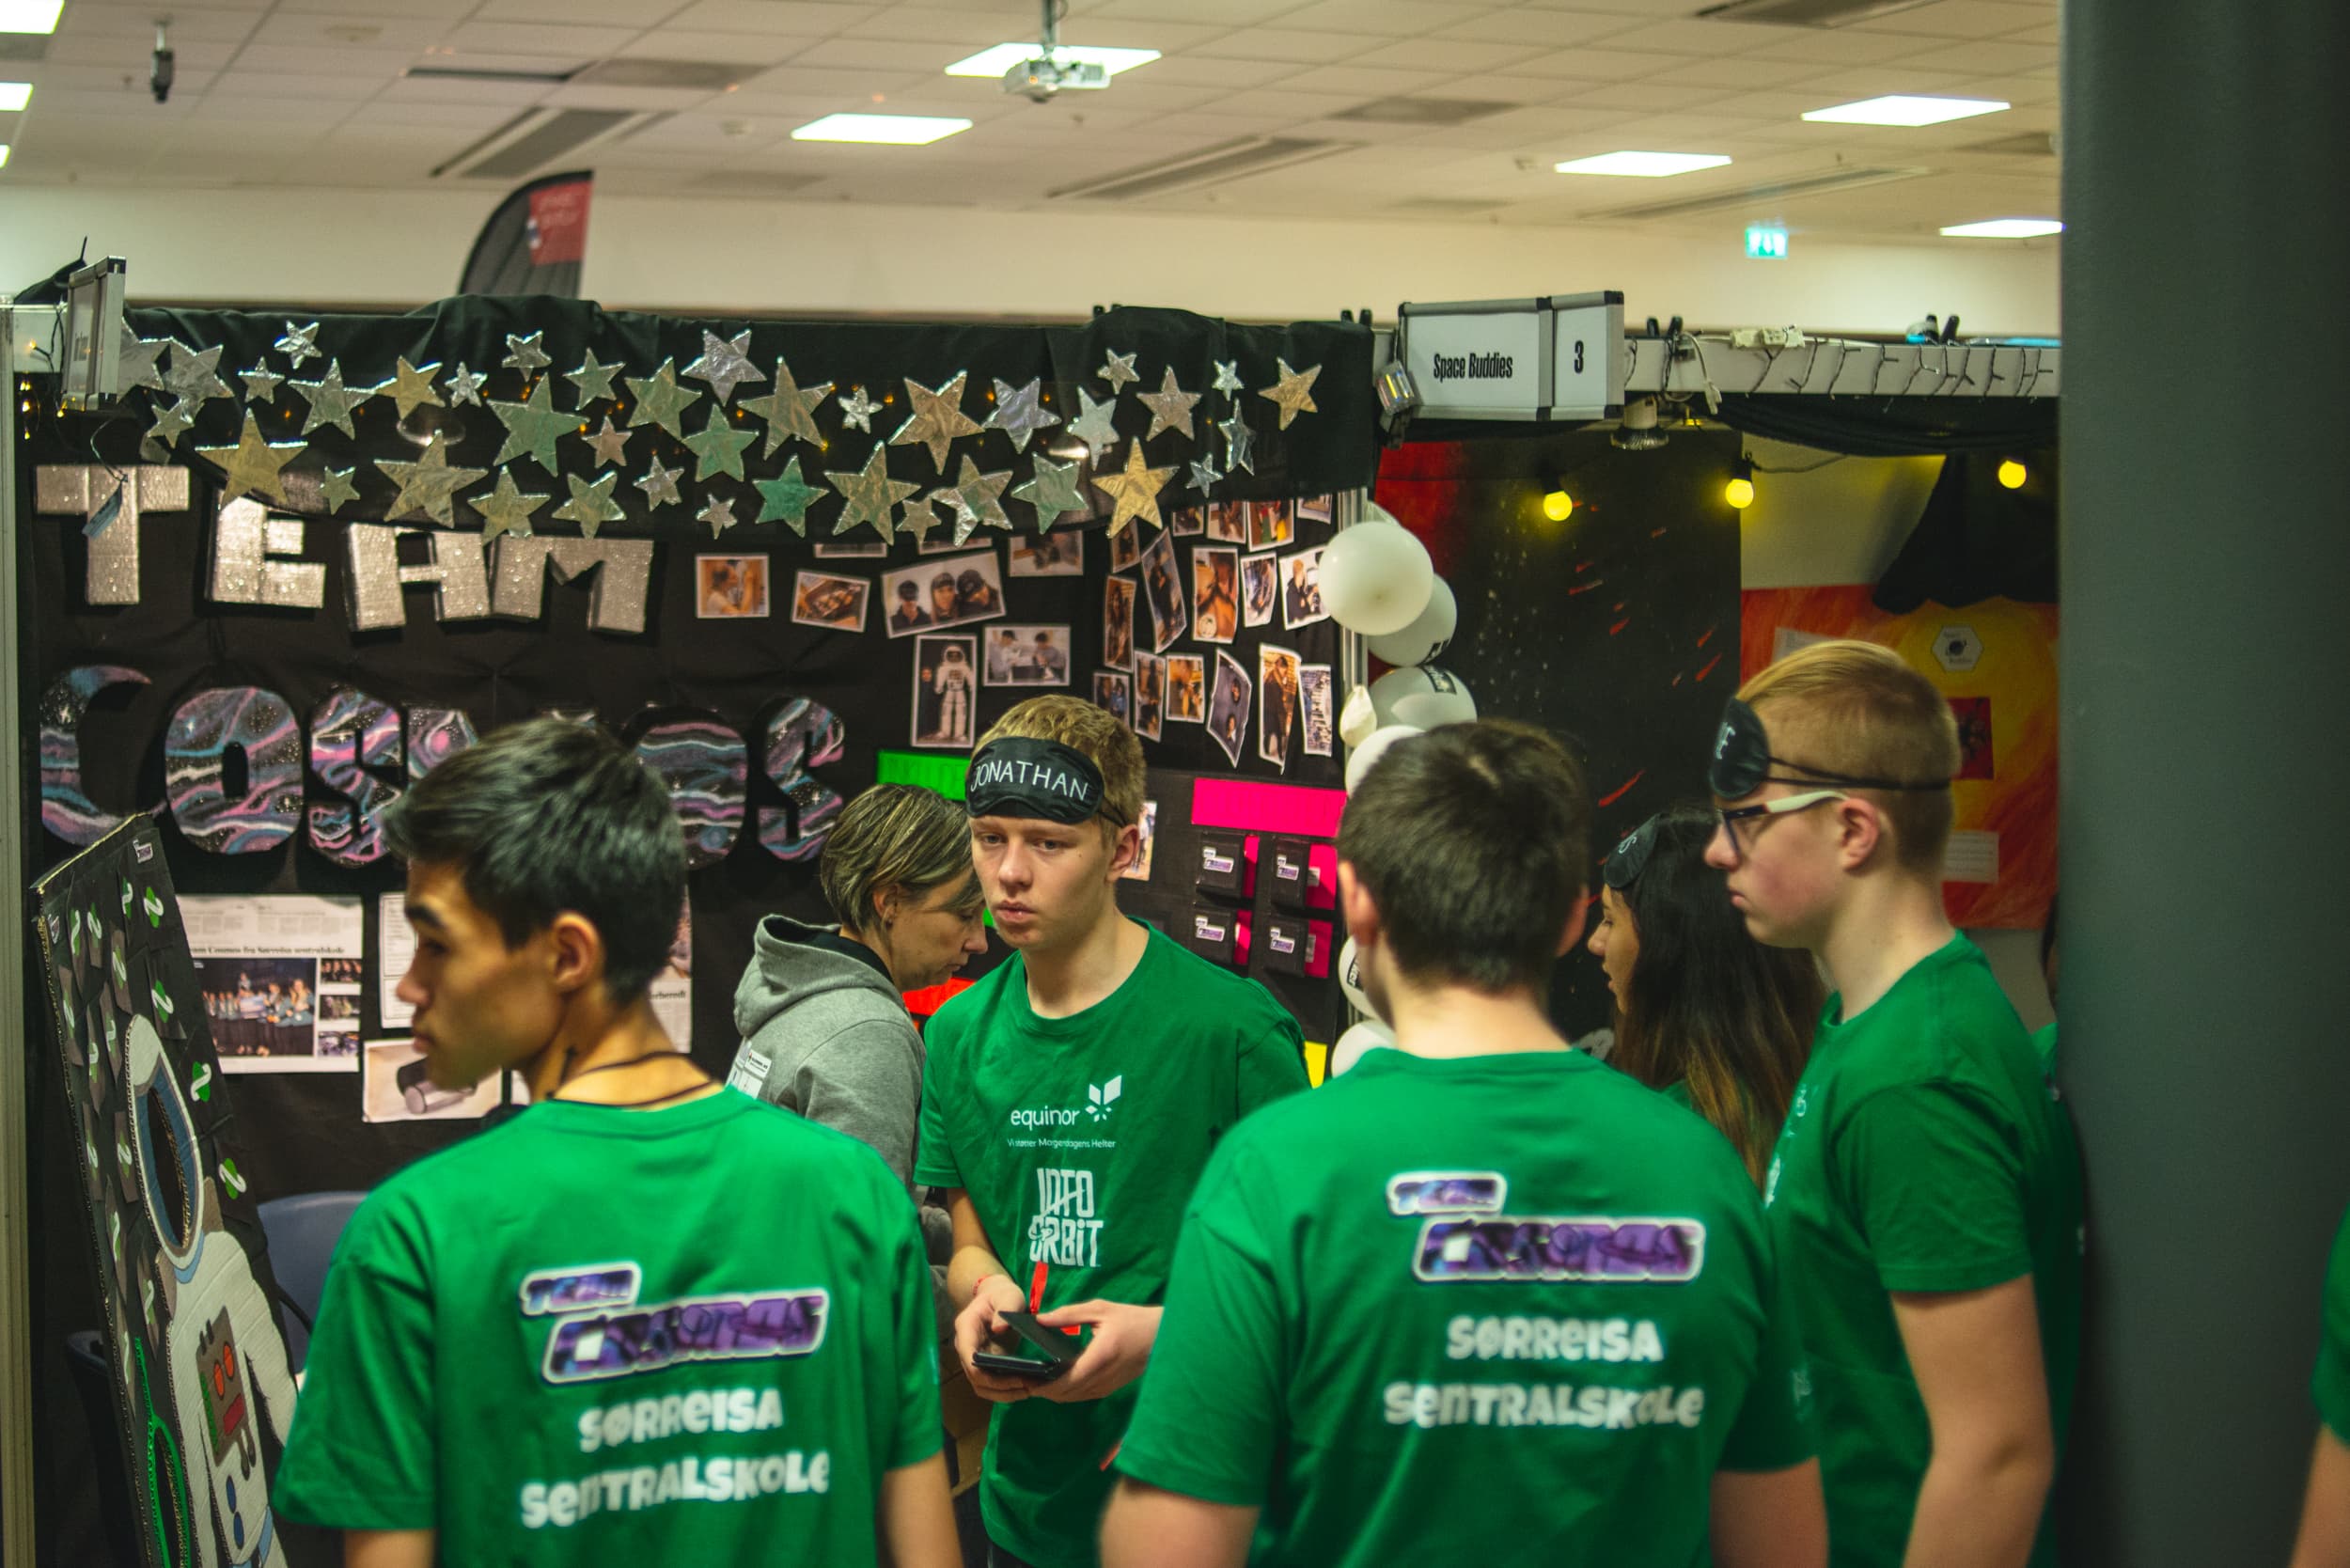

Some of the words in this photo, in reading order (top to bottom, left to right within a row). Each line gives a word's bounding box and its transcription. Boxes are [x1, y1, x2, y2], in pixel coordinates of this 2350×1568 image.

[1434, 353, 1465, 383] Space
[1468, 352, 1513, 379] Buddies
[1574, 340, 1584, 373] 3
[35, 464, 654, 633] TEAM
[40, 665, 845, 869] COSOS
[970, 760, 1089, 801] JONATHAN
[1010, 1105, 1080, 1131] equinor
[1091, 1138, 1116, 1148] Helter
